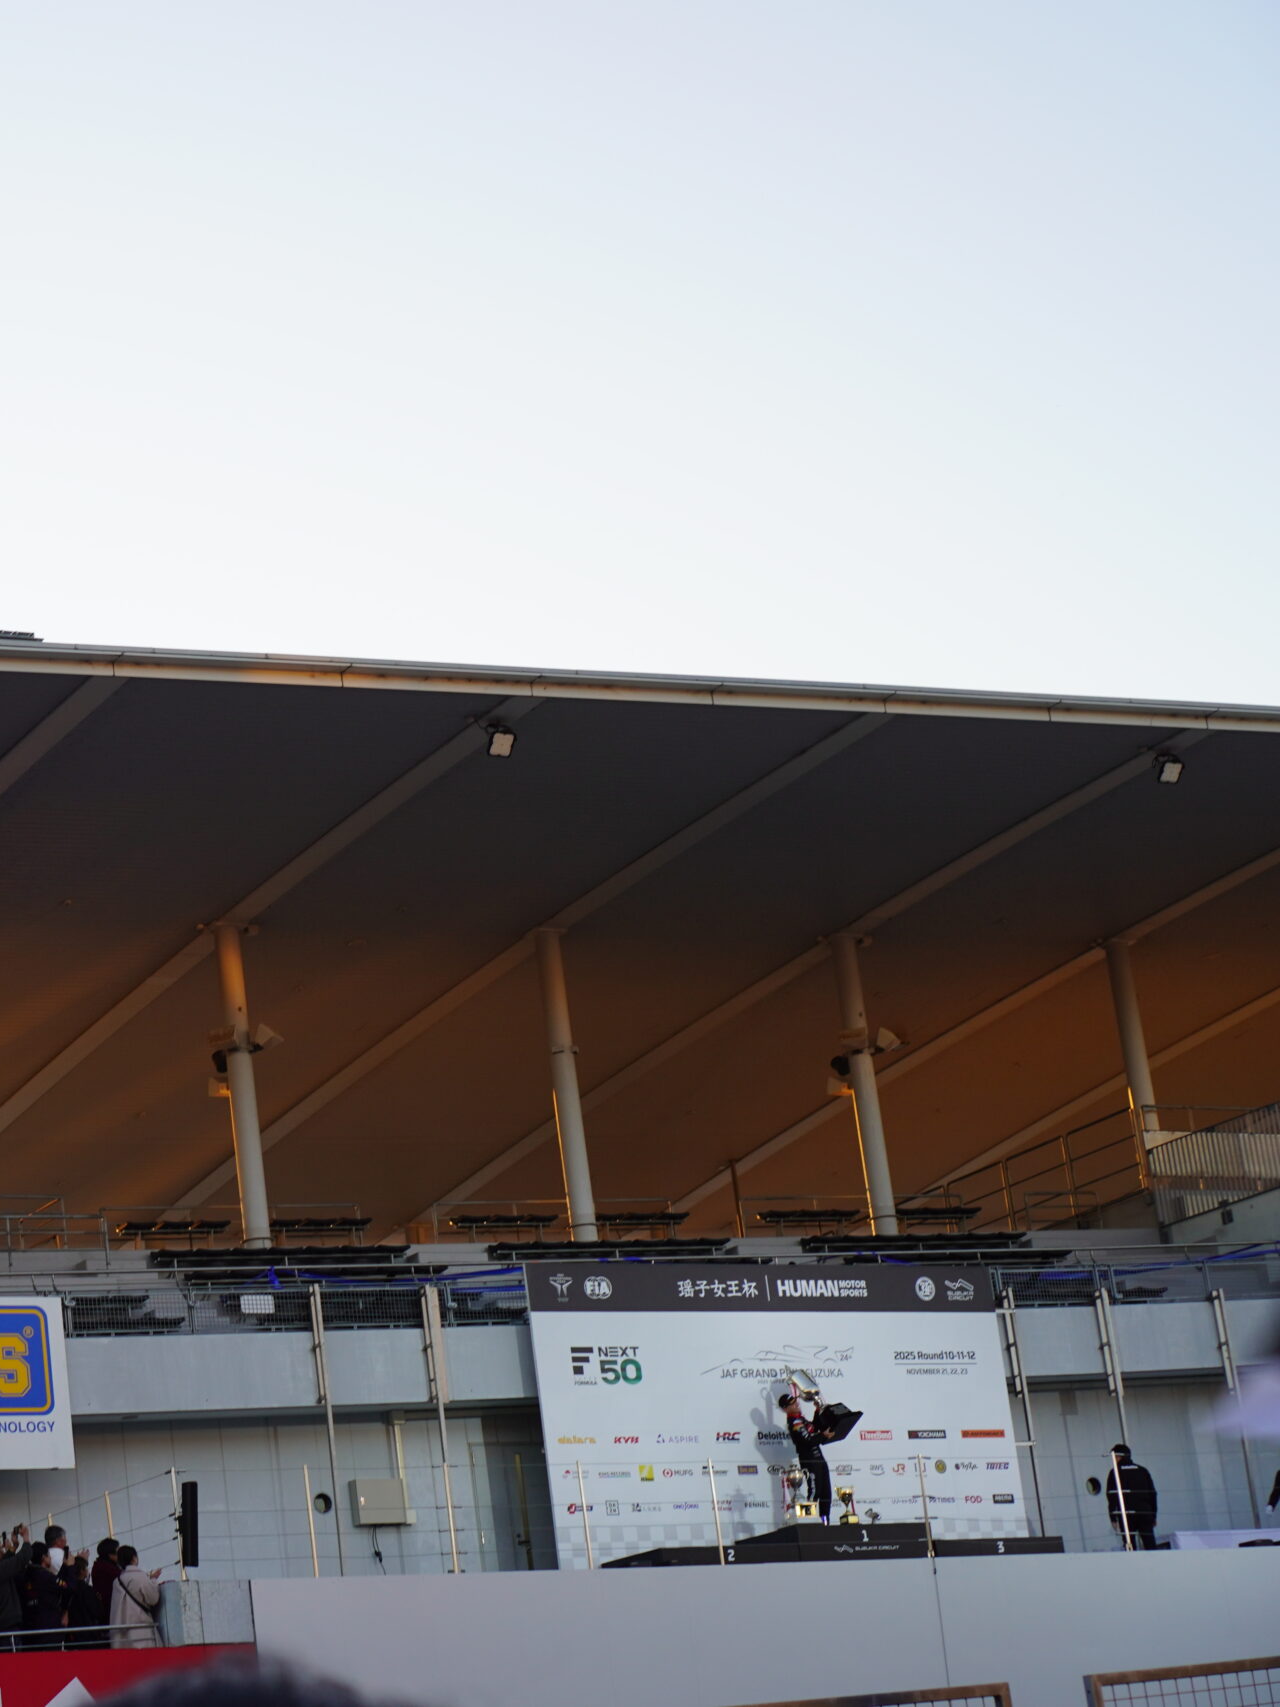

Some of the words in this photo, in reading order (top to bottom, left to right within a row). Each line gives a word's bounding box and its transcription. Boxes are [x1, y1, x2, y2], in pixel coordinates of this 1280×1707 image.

[586, 1280, 611, 1295] FIA
[677, 1279, 759, 1298] 瑶子女王杯
[777, 1279, 839, 1298] HUMAN
[838, 1280, 867, 1289] MOTOR
[840, 1288, 868, 1298] SPORTS
[598, 1346, 640, 1357] NEXT
[894, 1351, 915, 1360] 2025
[600, 1358, 643, 1385] 50
[720, 1369, 738, 1378] JAF
[740, 1368, 778, 1378] GRAND
[716, 1432, 740, 1440] HRC
[861, 1529, 869, 1542] 1
[996, 1541, 1006, 1553] 3
[727, 1549, 736, 1561] 2
